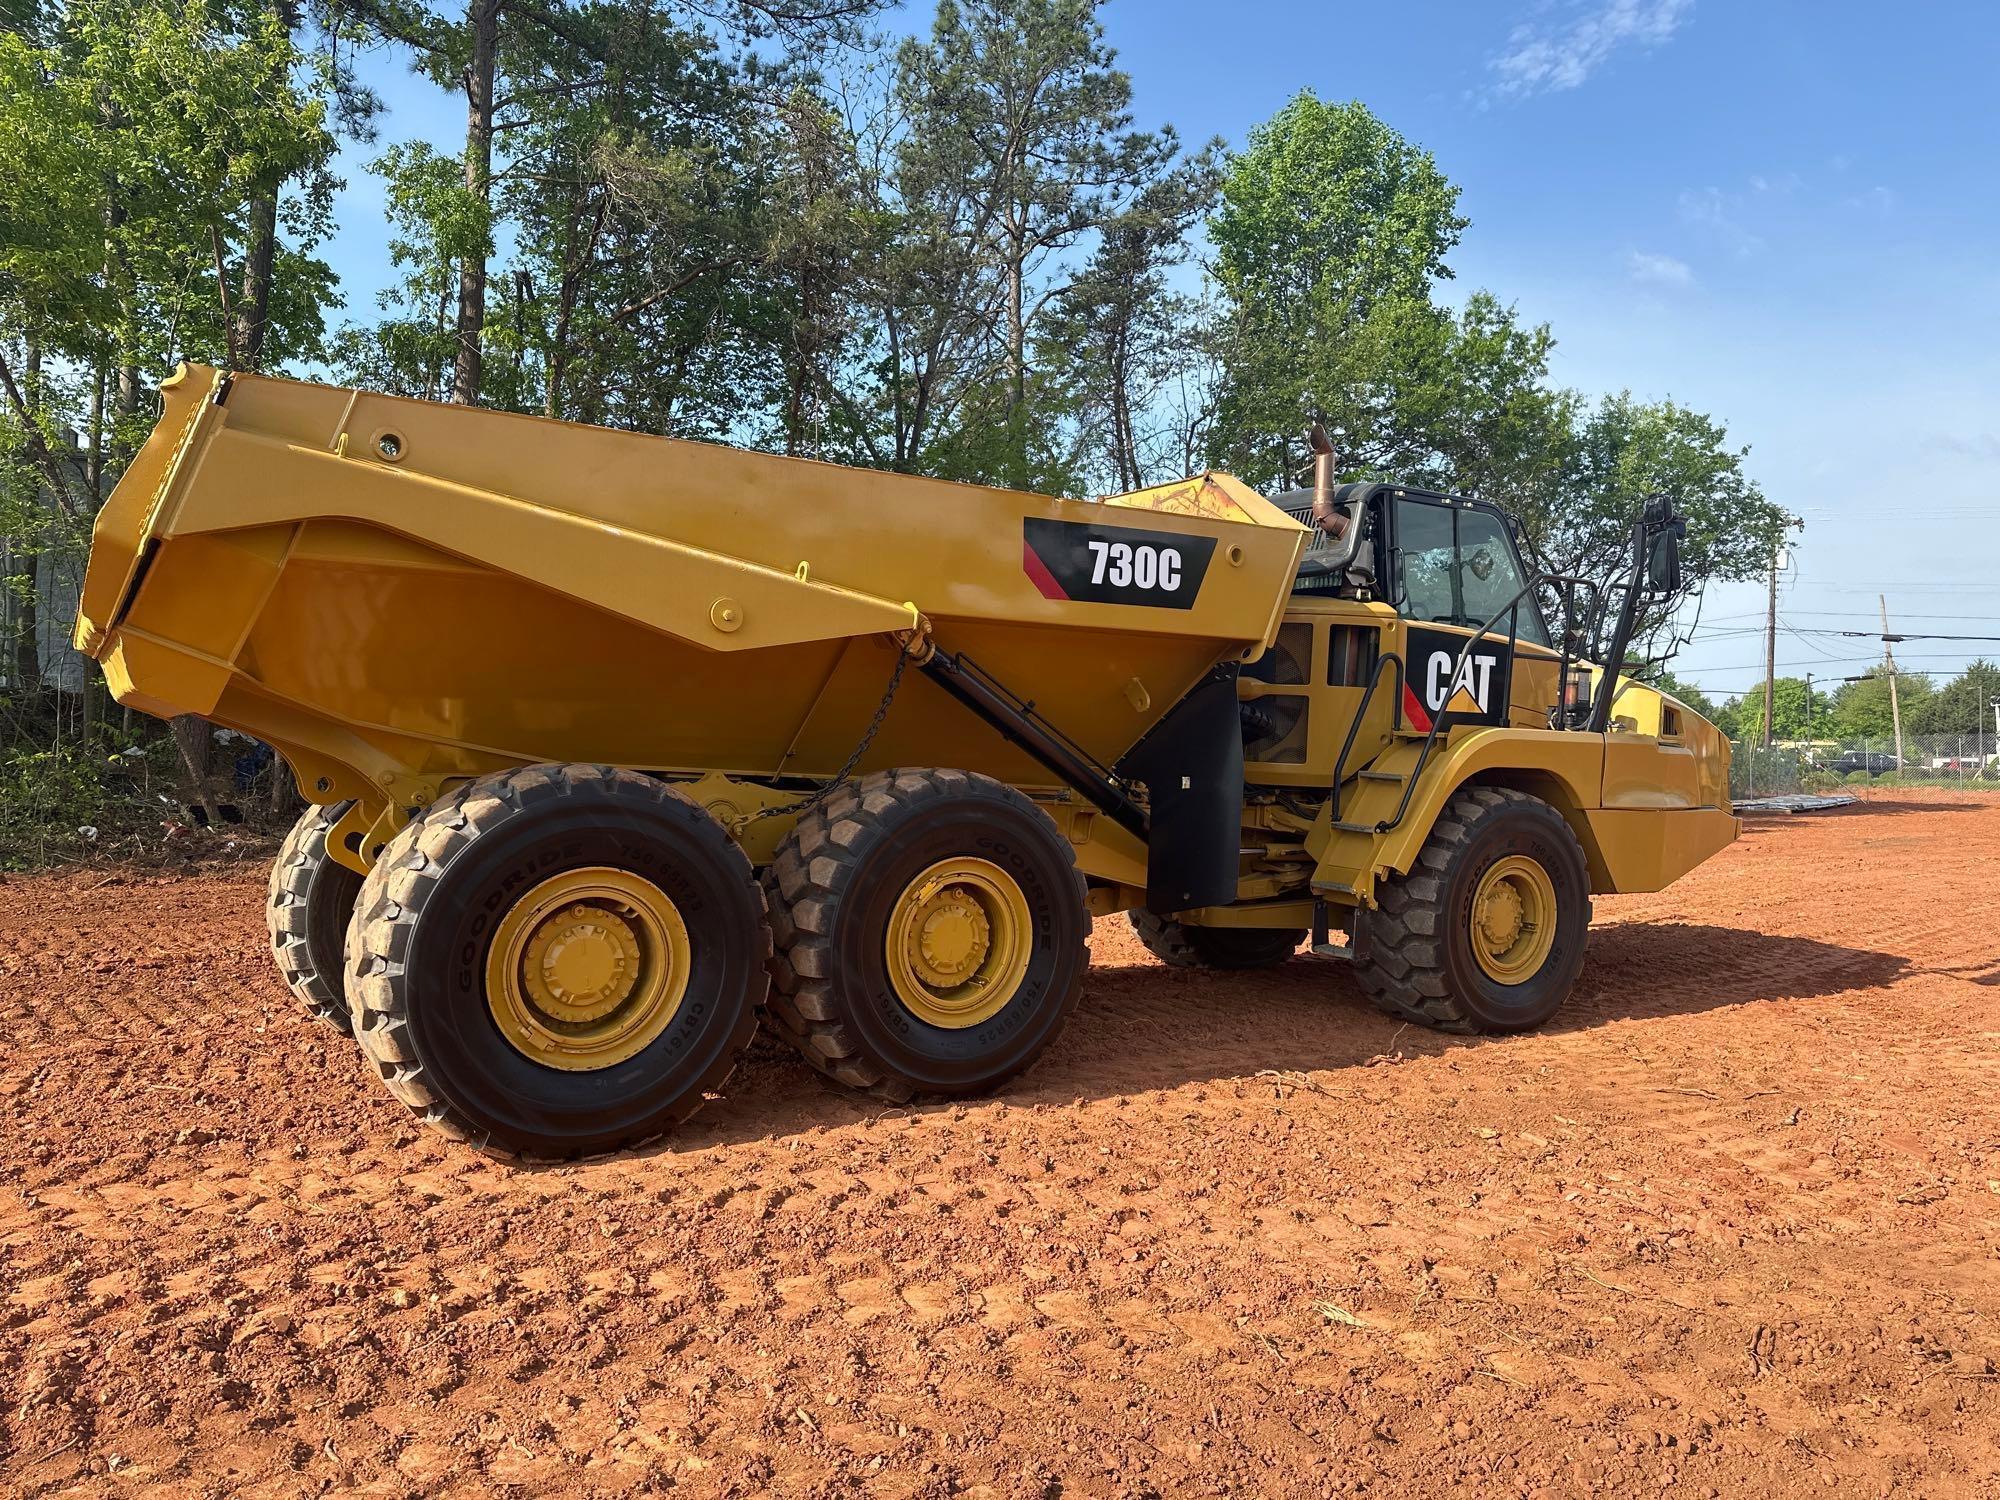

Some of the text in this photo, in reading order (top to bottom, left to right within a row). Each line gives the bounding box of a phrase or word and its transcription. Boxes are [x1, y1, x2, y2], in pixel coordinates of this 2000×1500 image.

[1088, 540, 1182, 592] 730C
[1426, 650, 1497, 714] CAT
[620, 843, 704, 912] 75065R25
[975, 836, 1052, 952] GOODRIDE
[459, 842, 583, 993] GOODRIDE
[662, 1002, 705, 1057] CB761
[877, 991, 910, 1034] CB761
